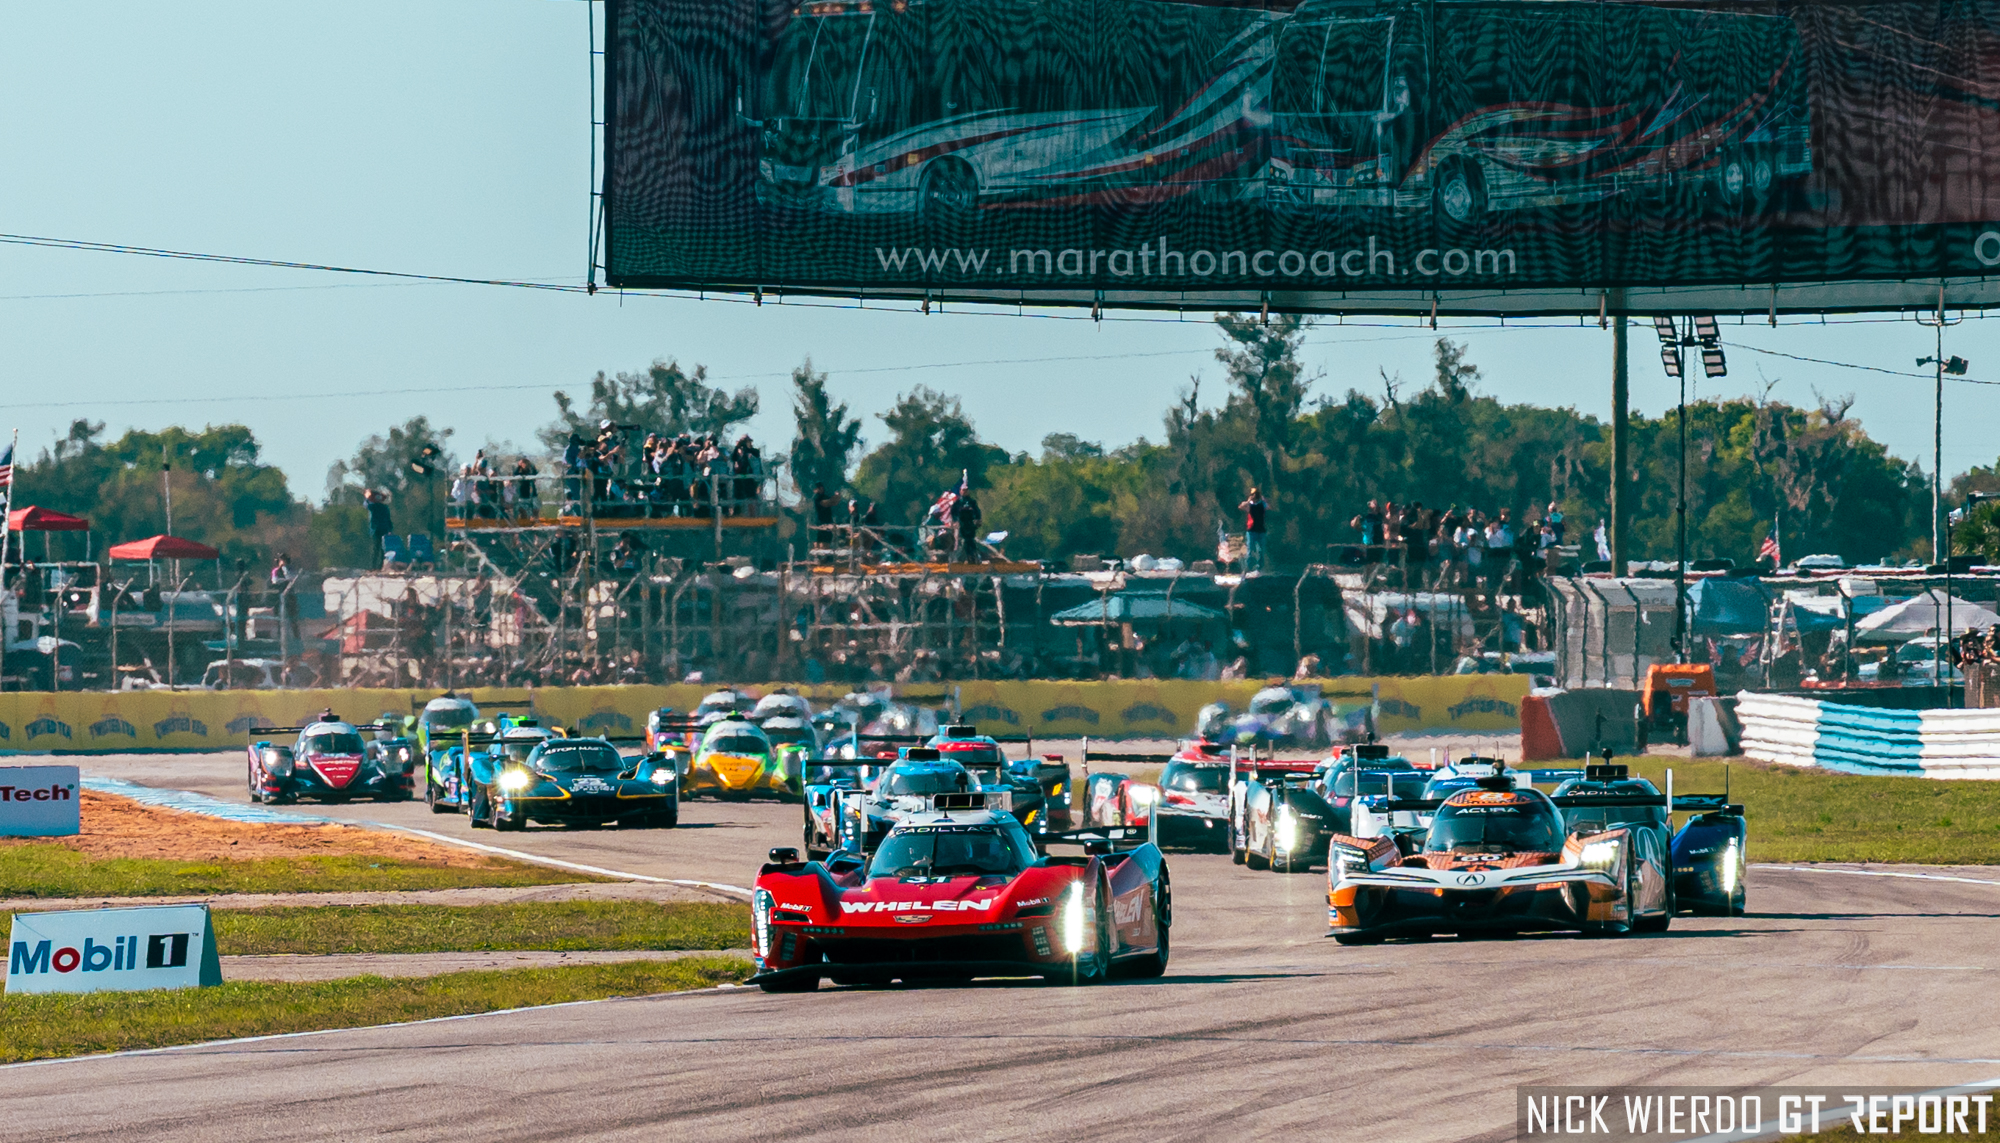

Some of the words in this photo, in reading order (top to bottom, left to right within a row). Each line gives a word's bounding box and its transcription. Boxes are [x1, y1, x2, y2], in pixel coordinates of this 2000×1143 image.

[875, 235, 1517, 276] www.marathoncoach.com
[1455, 807, 1520, 815] ACURA
[896, 826, 992, 835] CADILLAC
[780, 902, 803, 911] Mobil
[839, 898, 993, 913] WHELEN
[1016, 899, 1041, 907] Mobil
[10, 935, 138, 975] Mobil
